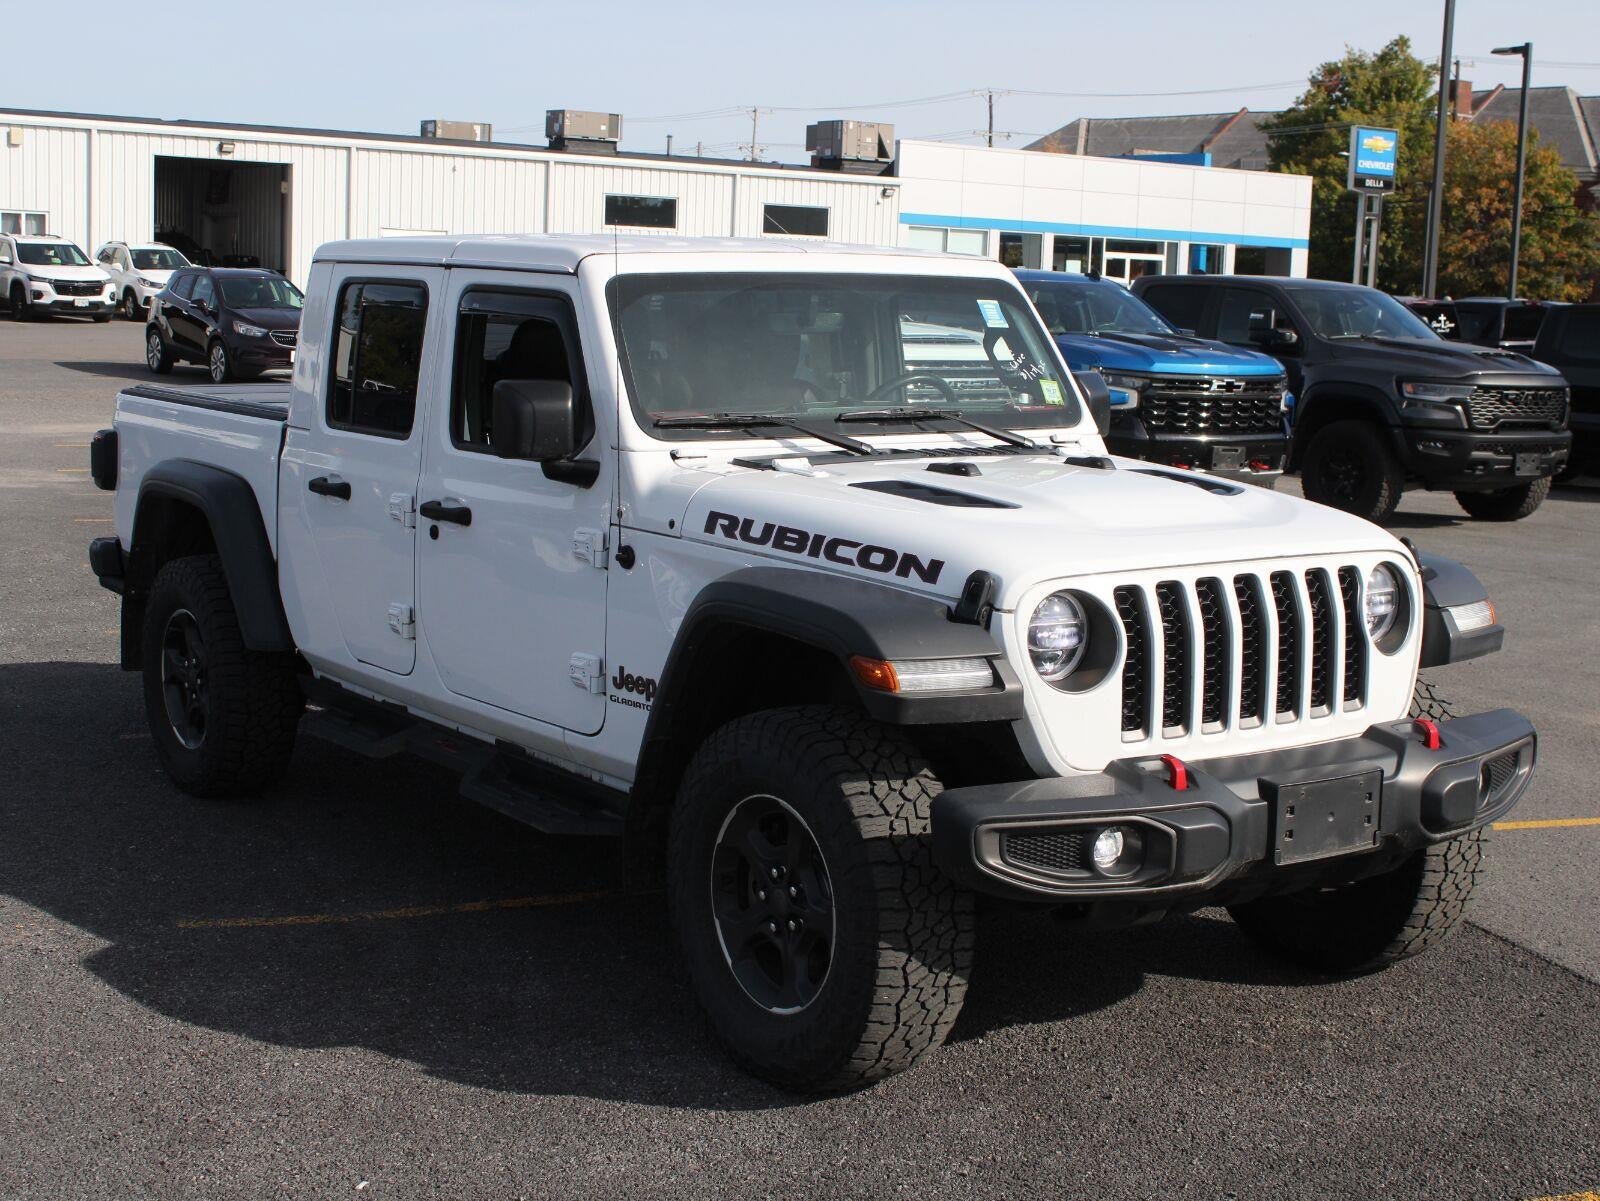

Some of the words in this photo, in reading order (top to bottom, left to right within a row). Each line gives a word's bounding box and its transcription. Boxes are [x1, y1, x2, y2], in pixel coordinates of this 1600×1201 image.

[1358, 160, 1394, 171] CHEVROLET
[1365, 179, 1384, 188] DELLA
[704, 510, 945, 585] RUBICON
[612, 665, 657, 702] Jeep
[610, 694, 652, 711] GLADIATO
